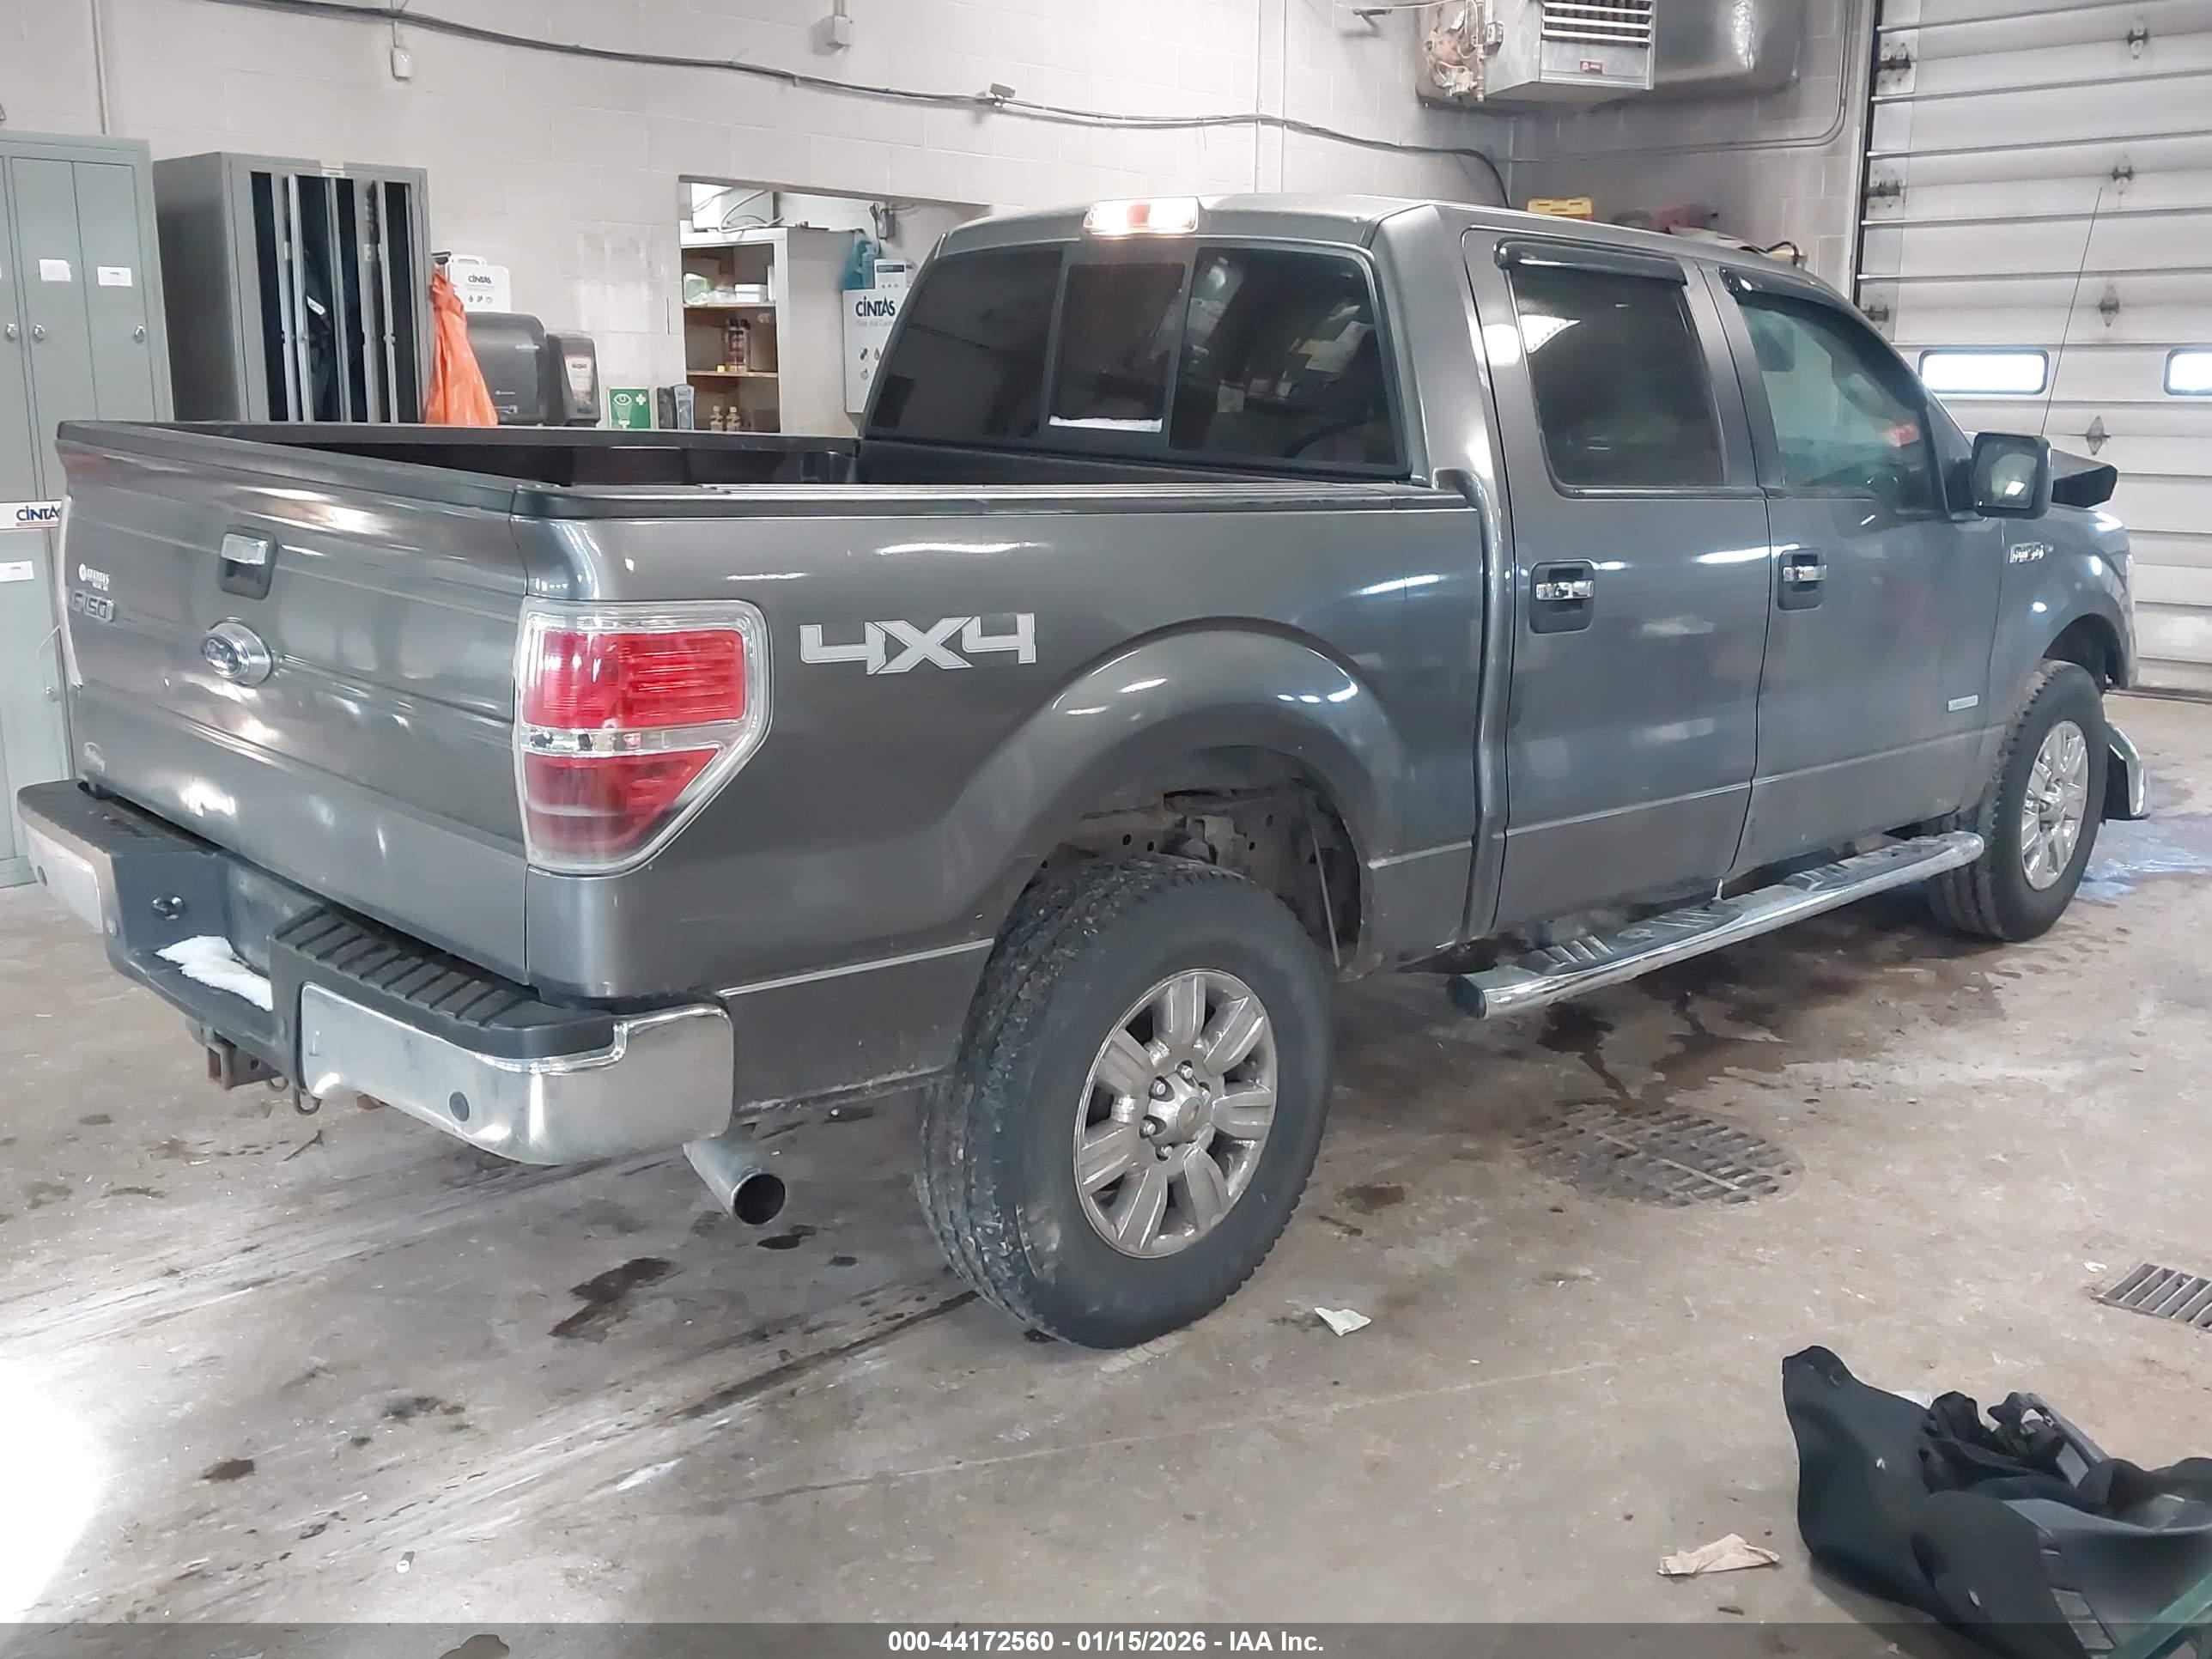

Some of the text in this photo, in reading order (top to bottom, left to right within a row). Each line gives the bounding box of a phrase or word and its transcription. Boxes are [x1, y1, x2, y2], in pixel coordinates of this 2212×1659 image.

[855, 295, 896, 317] CINTAS
[15, 505, 61, 521] CINTA
[799, 612, 1036, 676] 4X4
